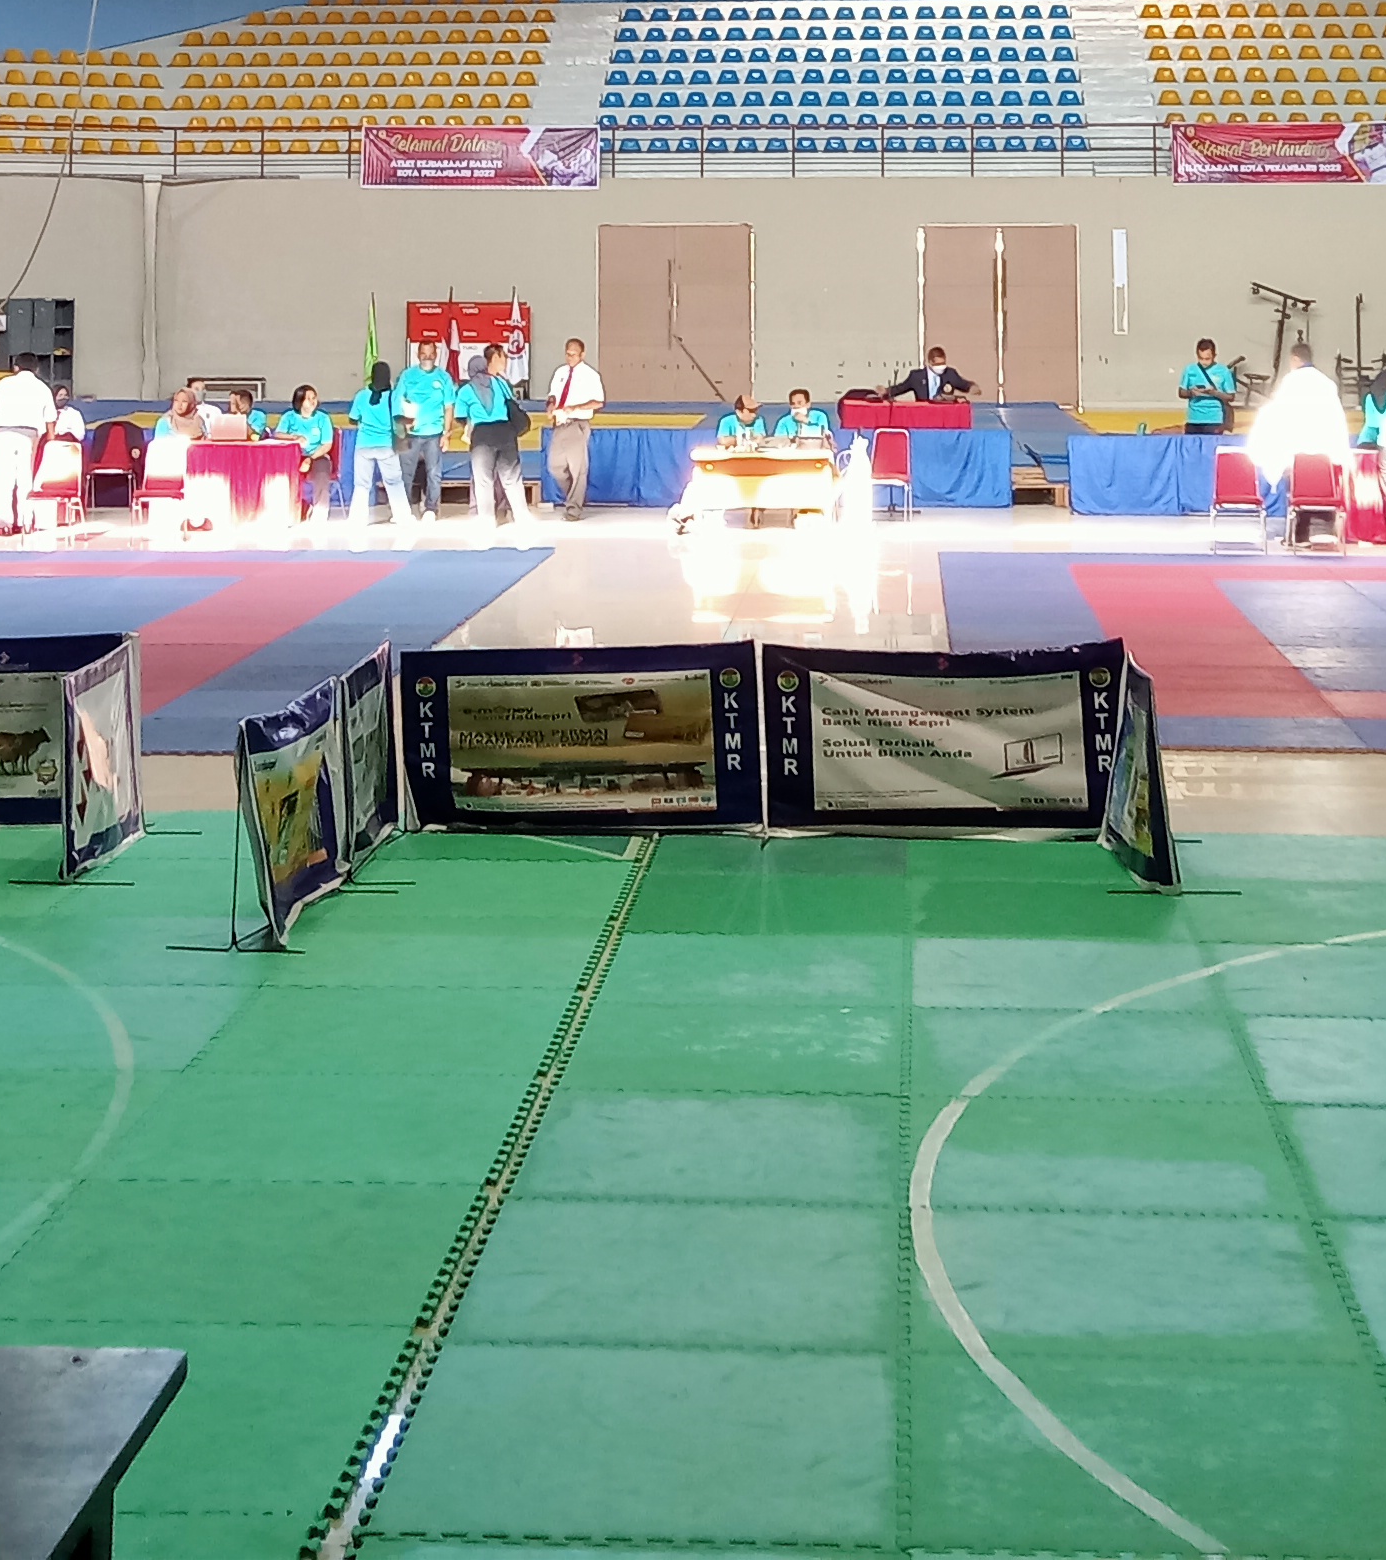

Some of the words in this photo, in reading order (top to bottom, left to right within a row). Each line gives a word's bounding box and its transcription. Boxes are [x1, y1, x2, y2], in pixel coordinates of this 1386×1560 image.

[723, 691, 743, 771] KTMR
[821, 706, 859, 717] Cash
[865, 707, 971, 718] Management
[976, 706, 1034, 717] System
[822, 718, 861, 727] Bank
[867, 718, 903, 727] Riau
[908, 718, 951, 729] Kepri
[1093, 691, 1112, 773] KTMR
[419, 701, 437, 779] KTMR
[781, 695, 800, 777] KTMR
[821, 738, 874, 748] Solusi
[876, 738, 935, 748] Terbaik
[822, 749, 873, 759] Untuk
[878, 749, 924, 758] Bisnis
[929, 749, 973, 758] Anda
